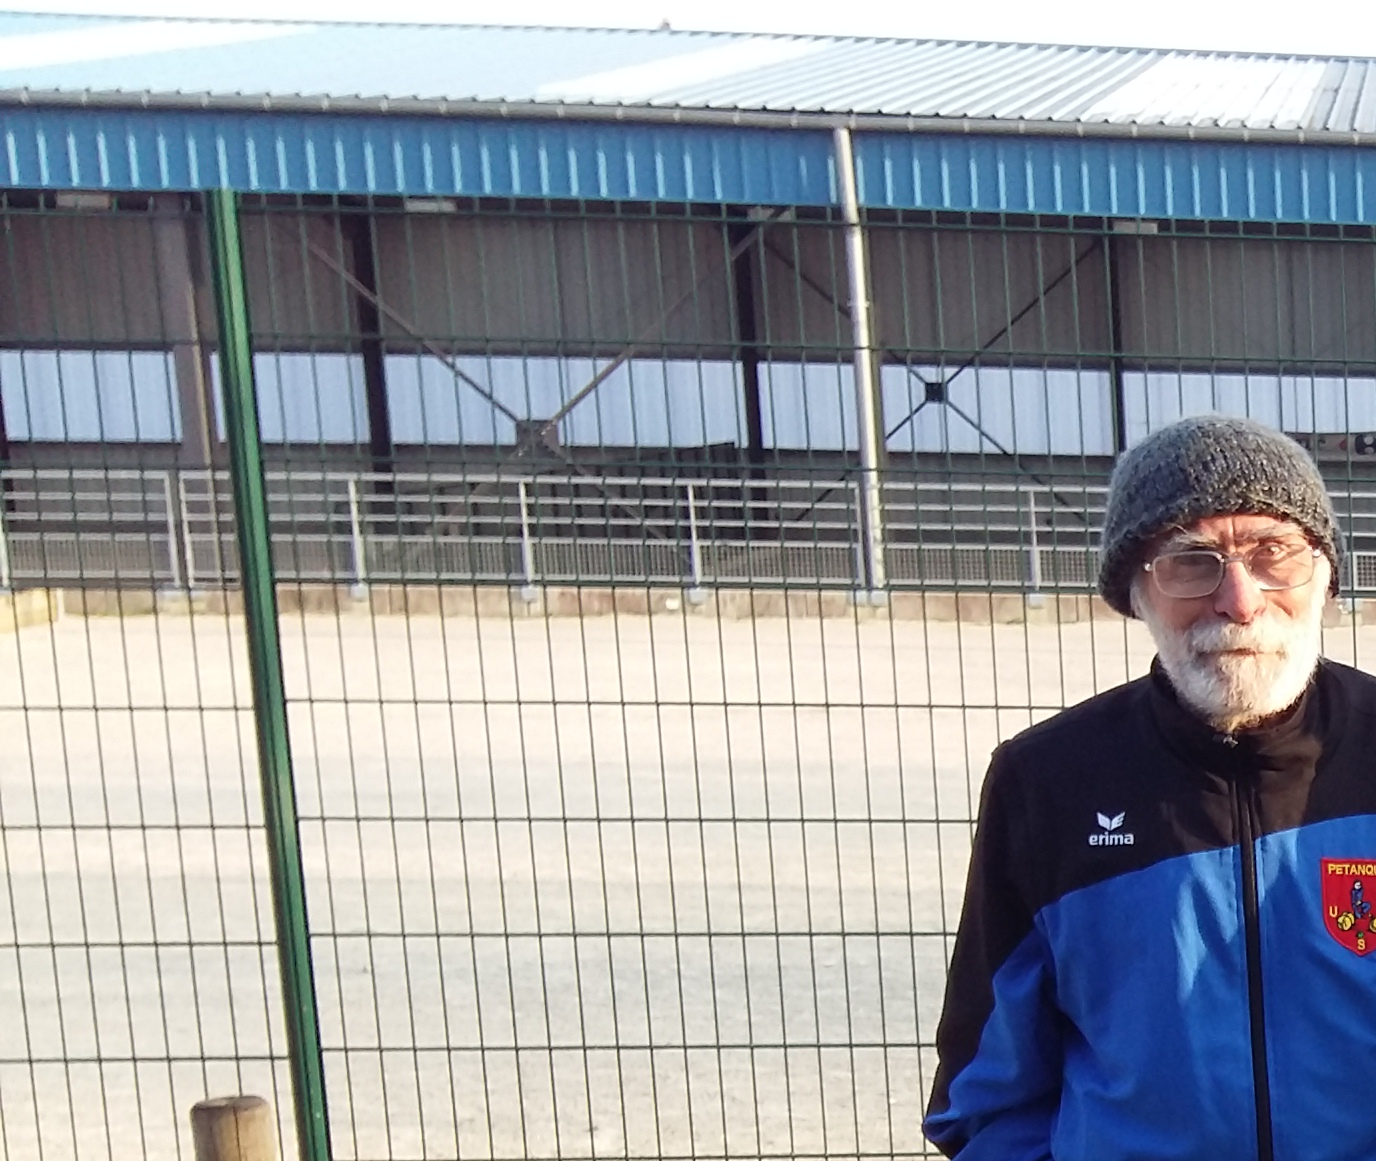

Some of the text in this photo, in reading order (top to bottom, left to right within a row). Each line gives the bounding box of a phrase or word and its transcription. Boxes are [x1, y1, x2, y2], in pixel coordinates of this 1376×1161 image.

[1088, 831, 1134, 846] erima
[1329, 906, 1338, 917] U
[1357, 938, 1366, 951] S
